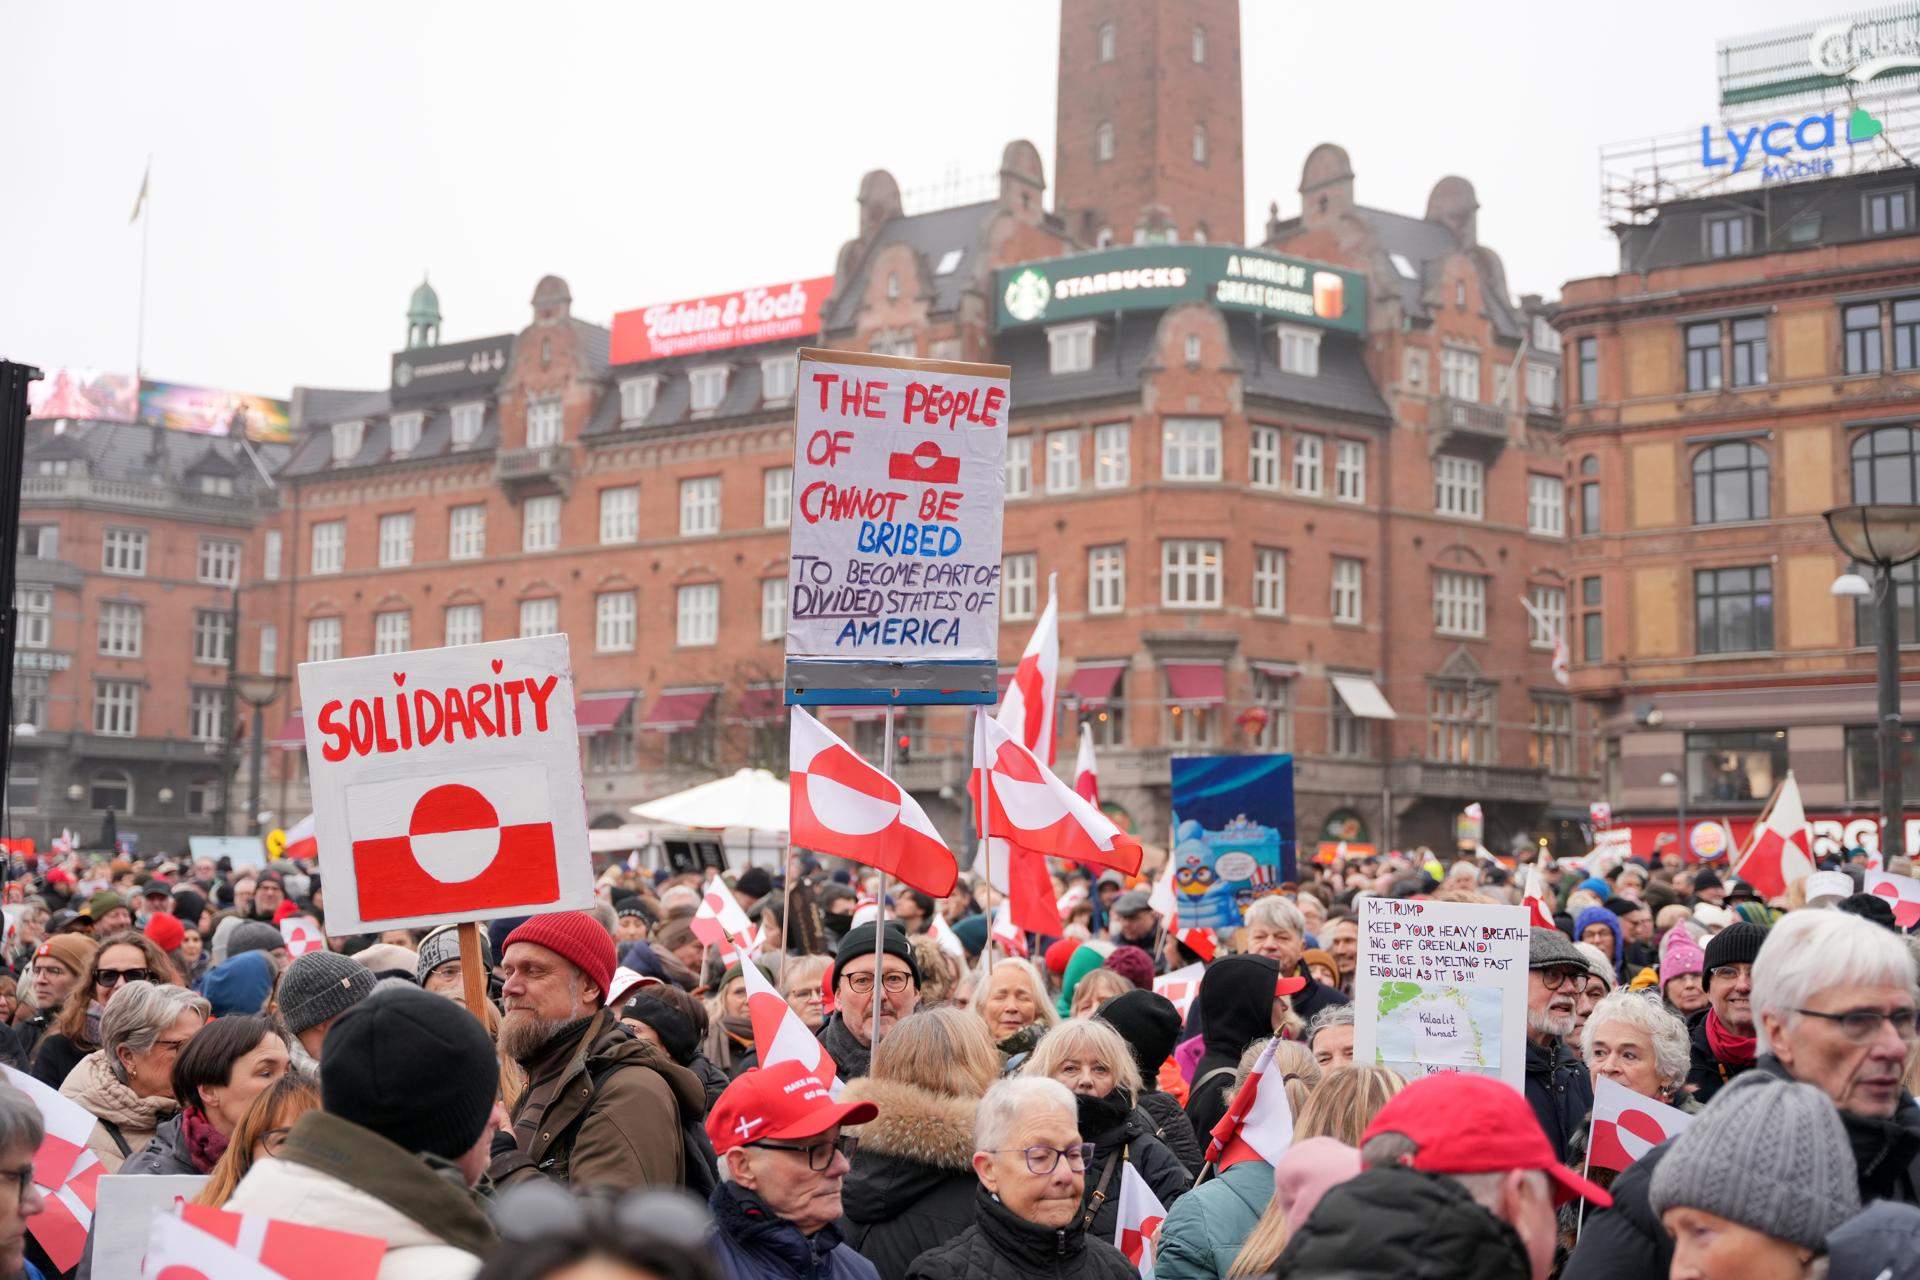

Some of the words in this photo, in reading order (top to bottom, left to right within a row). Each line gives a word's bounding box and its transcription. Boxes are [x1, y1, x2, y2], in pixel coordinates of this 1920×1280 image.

[1702, 112, 1835, 173] Lyca
[1762, 158, 1834, 183] Mobile
[1055, 268, 1186, 298] STARBUCKS
[1227, 255, 1240, 276] A
[1288, 265, 1306, 288] OF
[721, 298, 739, 327] &
[740, 283, 807, 324] Koch
[813, 374, 888, 418] THE
[903, 382, 1006, 430] PEOPLE
[806, 429, 854, 468] OF
[800, 481, 908, 524] CANNOT
[918, 488, 964, 522] BE
[857, 521, 962, 558] BRIBED
[792, 555, 832, 585] TO
[846, 560, 922, 586] BECOME
[923, 563, 974, 588] PART
[974, 565, 1000, 586] OF
[887, 590, 961, 614] STATES
[964, 592, 995, 613] OF
[836, 617, 961, 646] AMERICA
[1368, 901, 1386, 915] Mr.
[1386, 902, 1424, 916] TRUMP
[1368, 921, 1402, 934] KEEP
[1405, 923, 1436, 938] YOUR
[1439, 925, 1478, 938] HEAVY
[1391, 940, 1414, 950] OFF
[1418, 940, 1493, 953] GREENLAND!
[1368, 953, 1392, 964] THE
[1484, 958, 1513, 971] FAST
[1369, 967, 1412, 980] ENOUGH
[1416, 970, 1432, 981] AS
